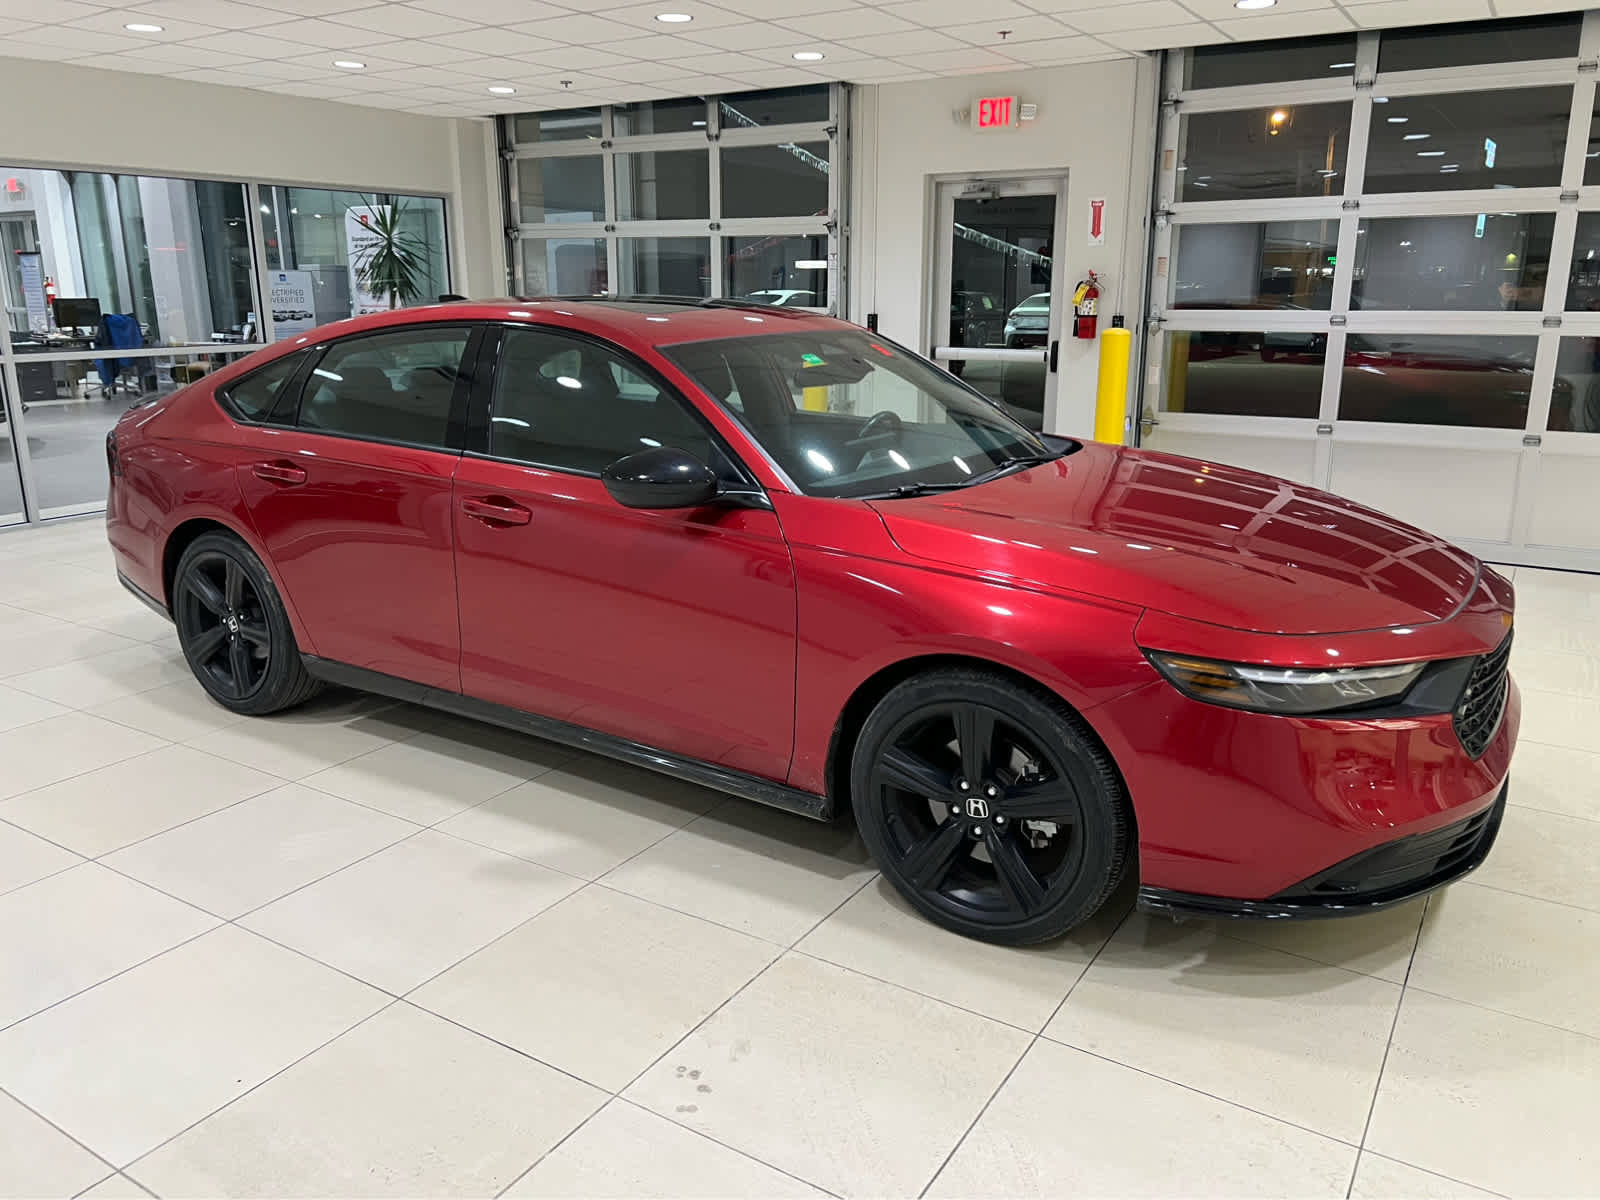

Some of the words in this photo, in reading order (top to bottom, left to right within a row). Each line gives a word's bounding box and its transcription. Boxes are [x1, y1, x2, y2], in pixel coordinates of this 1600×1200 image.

[979, 97, 1013, 128] EXIT
[271, 288, 304, 297] ECTRIFIED
[271, 296, 305, 304] VERSIFIED
